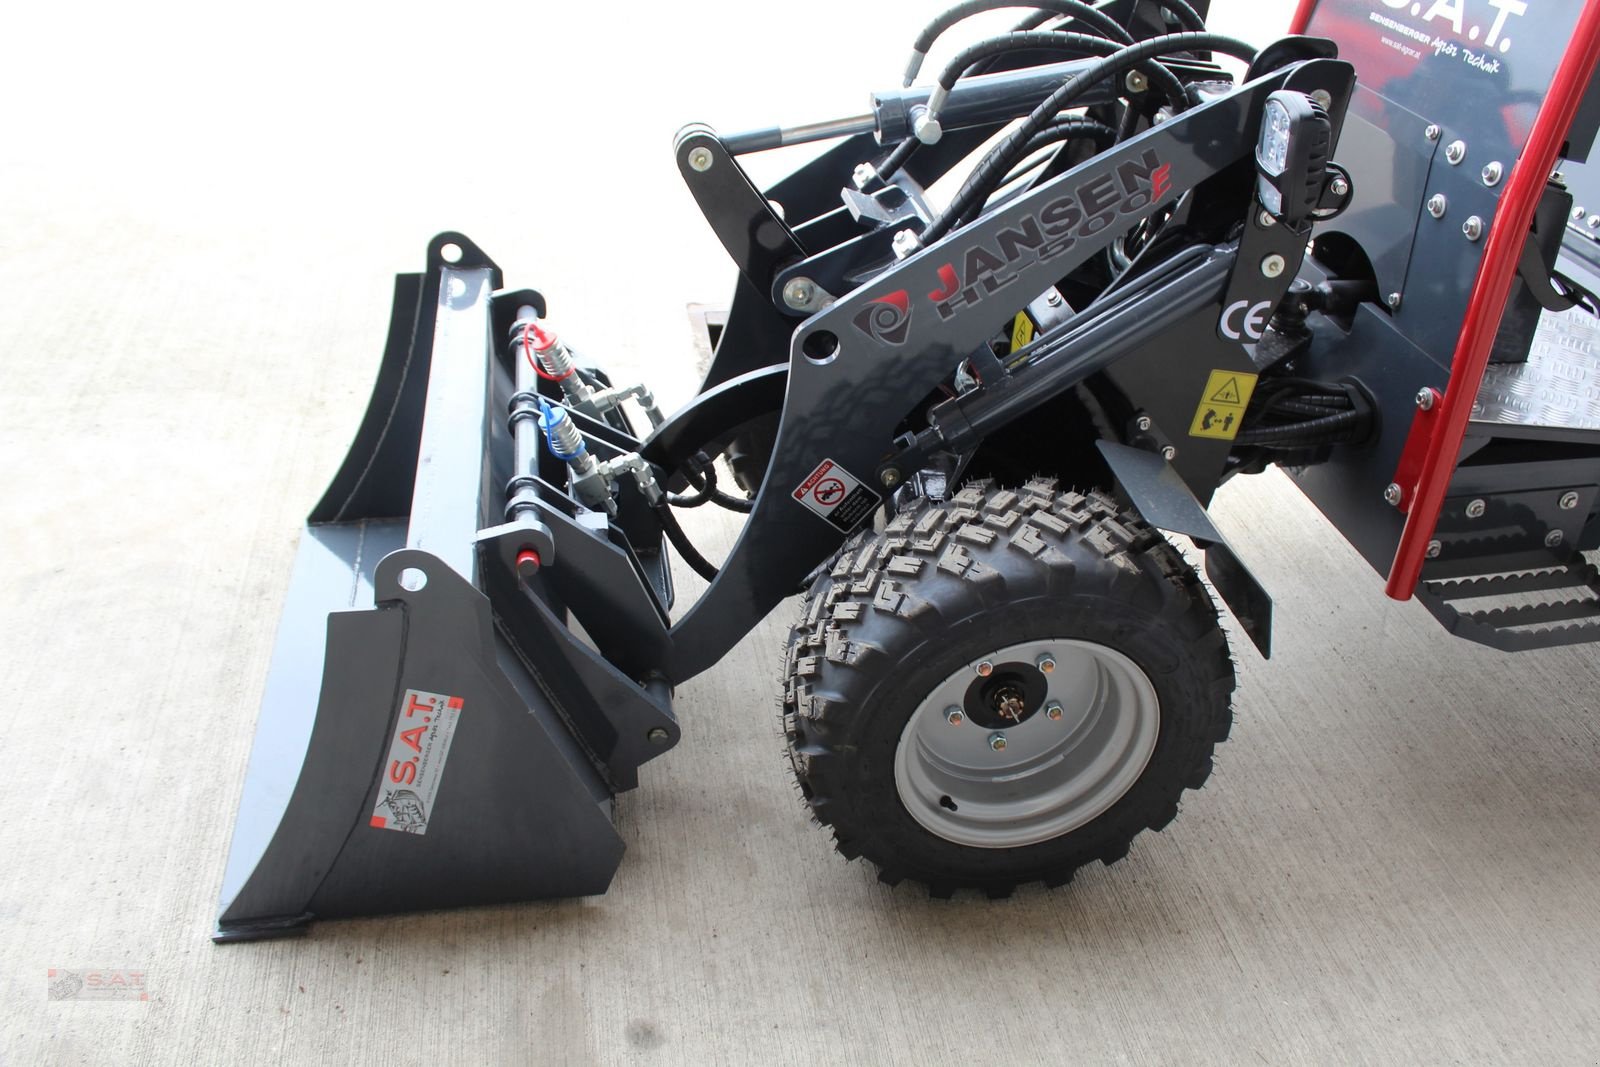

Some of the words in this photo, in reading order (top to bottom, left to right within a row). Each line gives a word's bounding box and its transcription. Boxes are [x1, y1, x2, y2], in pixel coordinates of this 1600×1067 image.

[1369, 12, 1431, 44] SENSENBERGER
[1463, 49, 1500, 74] Technik
[1381, 0, 1528, 53] .A.T.
[928, 149, 1161, 302] JANSEN
[1220, 300, 1272, 340] CE
[807, 463, 830, 487] ACHTUNG
[389, 694, 437, 785] S.A.T.
